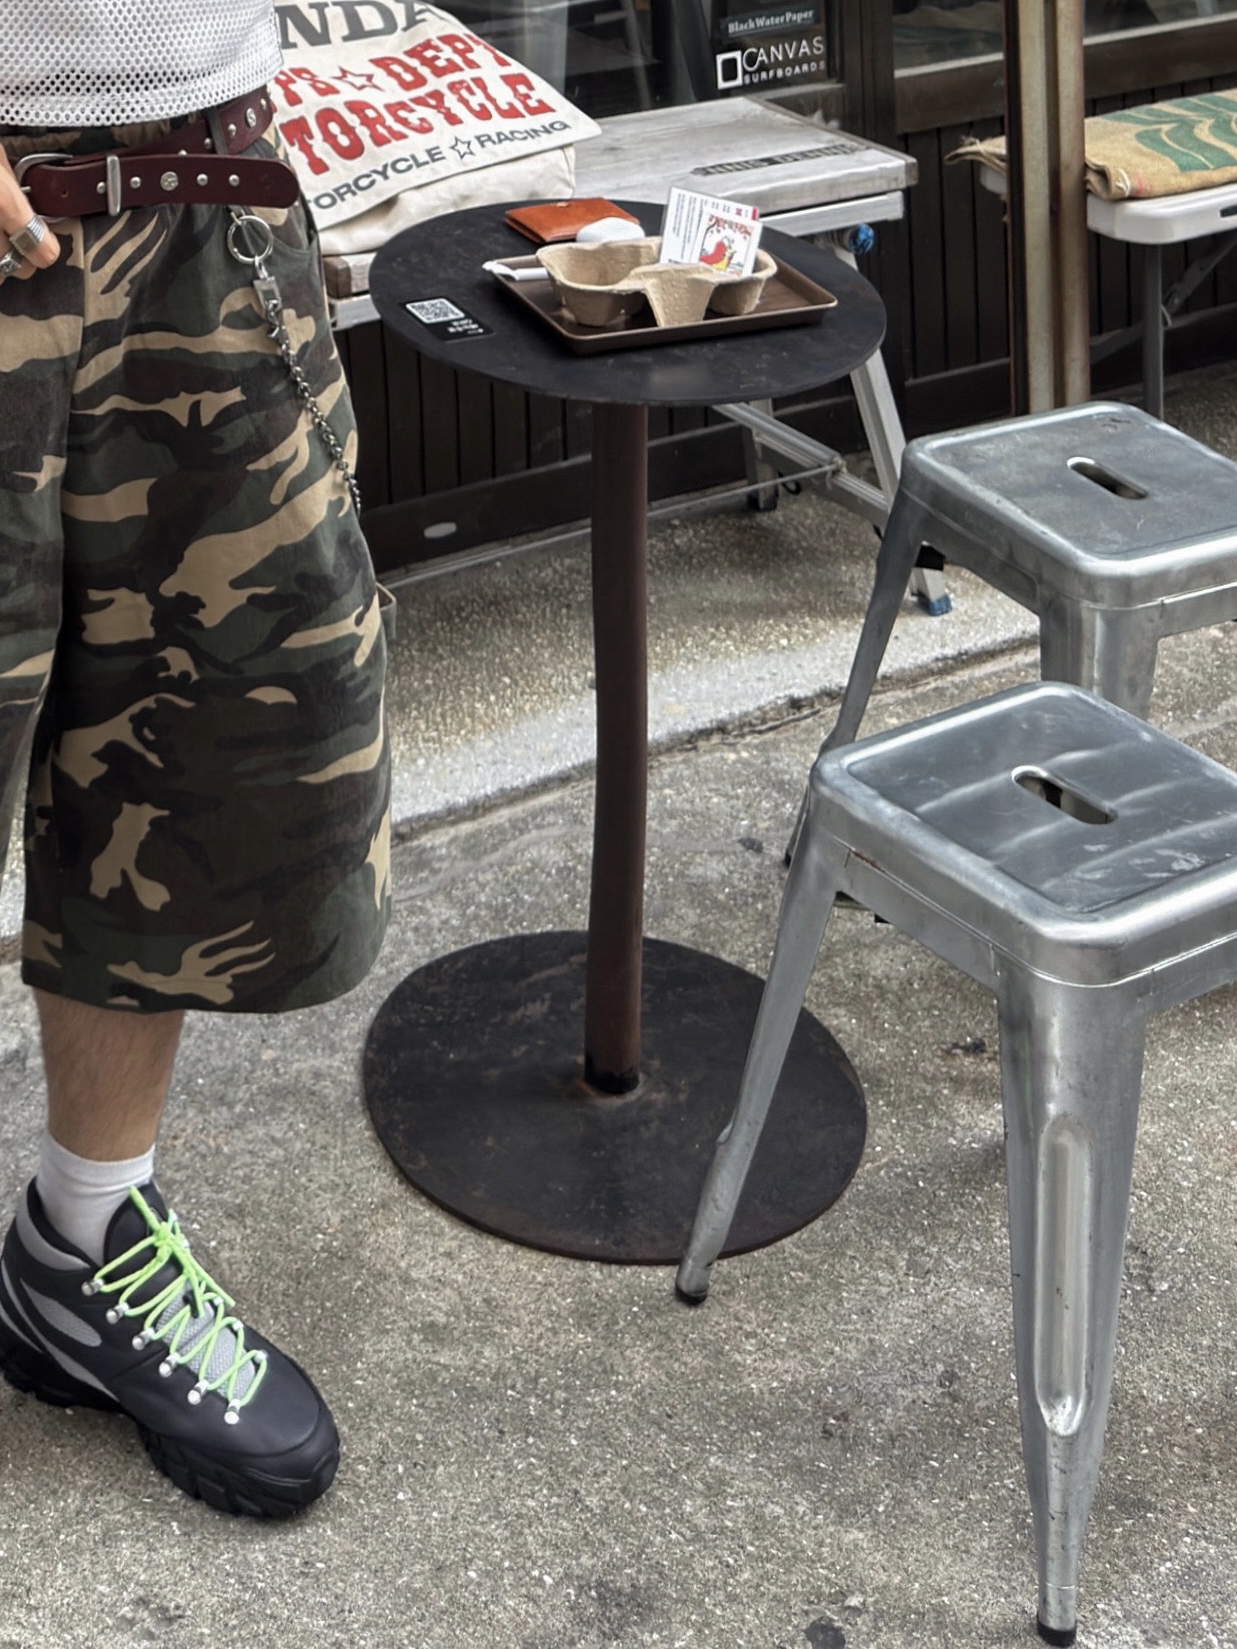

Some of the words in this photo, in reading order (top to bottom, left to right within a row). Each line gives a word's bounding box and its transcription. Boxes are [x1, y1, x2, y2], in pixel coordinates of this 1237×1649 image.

[743, 36, 824, 72] CANVAS
[744, 61, 826, 85] SURFBOARDS
[271, 73, 557, 175] TORCYCLE
[308, 146, 446, 209] ORCYCLE
[474, 120, 572, 149] RACING
